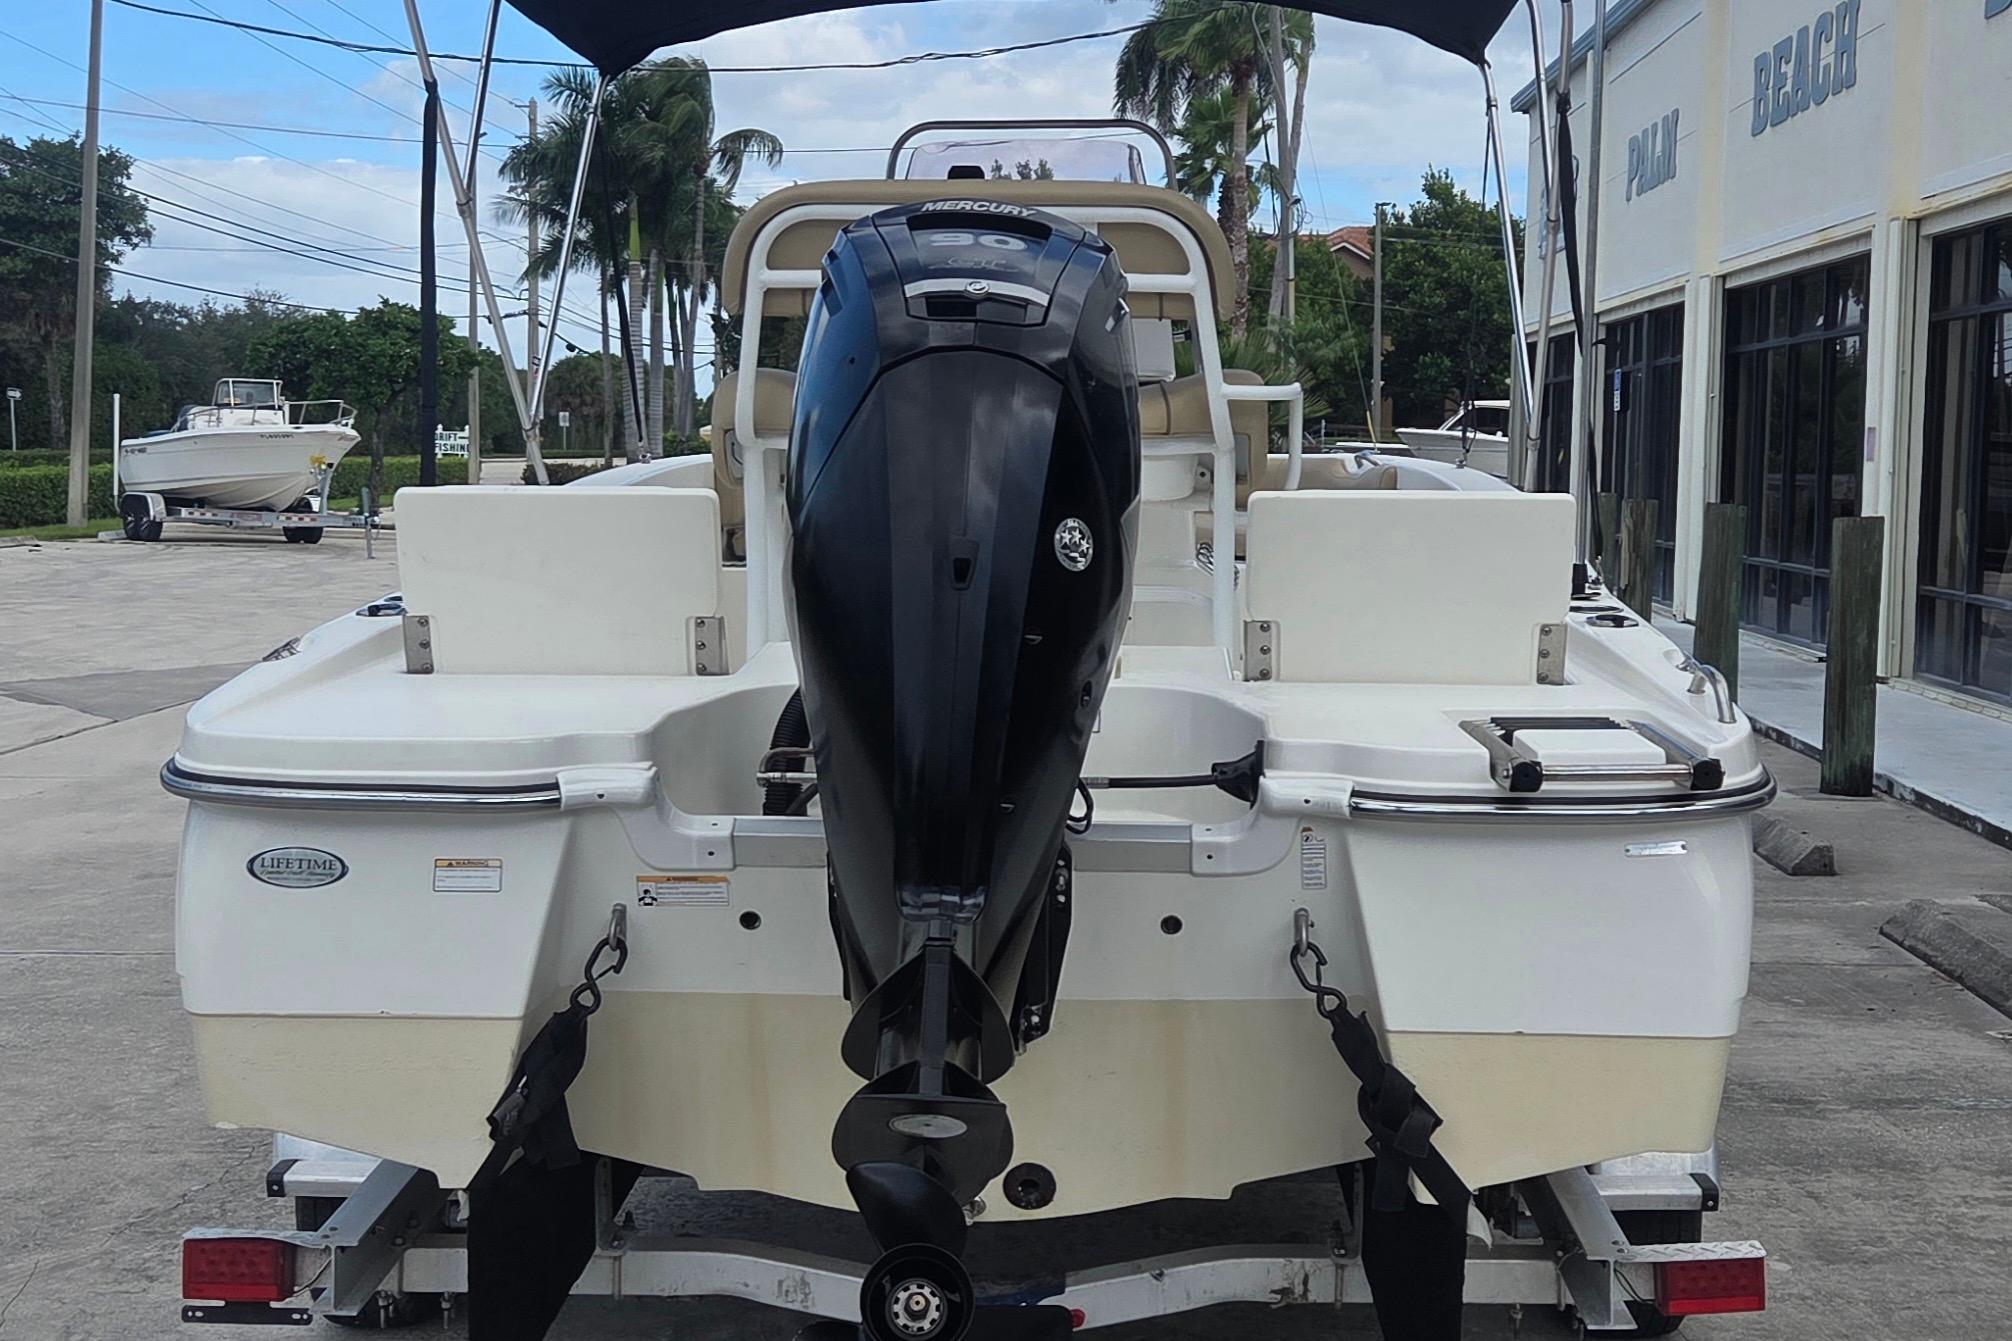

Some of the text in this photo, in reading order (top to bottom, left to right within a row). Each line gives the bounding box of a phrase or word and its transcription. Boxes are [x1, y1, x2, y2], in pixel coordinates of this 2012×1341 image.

[1625, 0, 1860, 202] PALM BEACH
[921, 200, 1038, 217] MERCURY
[929, 232, 1028, 250] 90
[260, 857, 338, 870] LIFETIME
